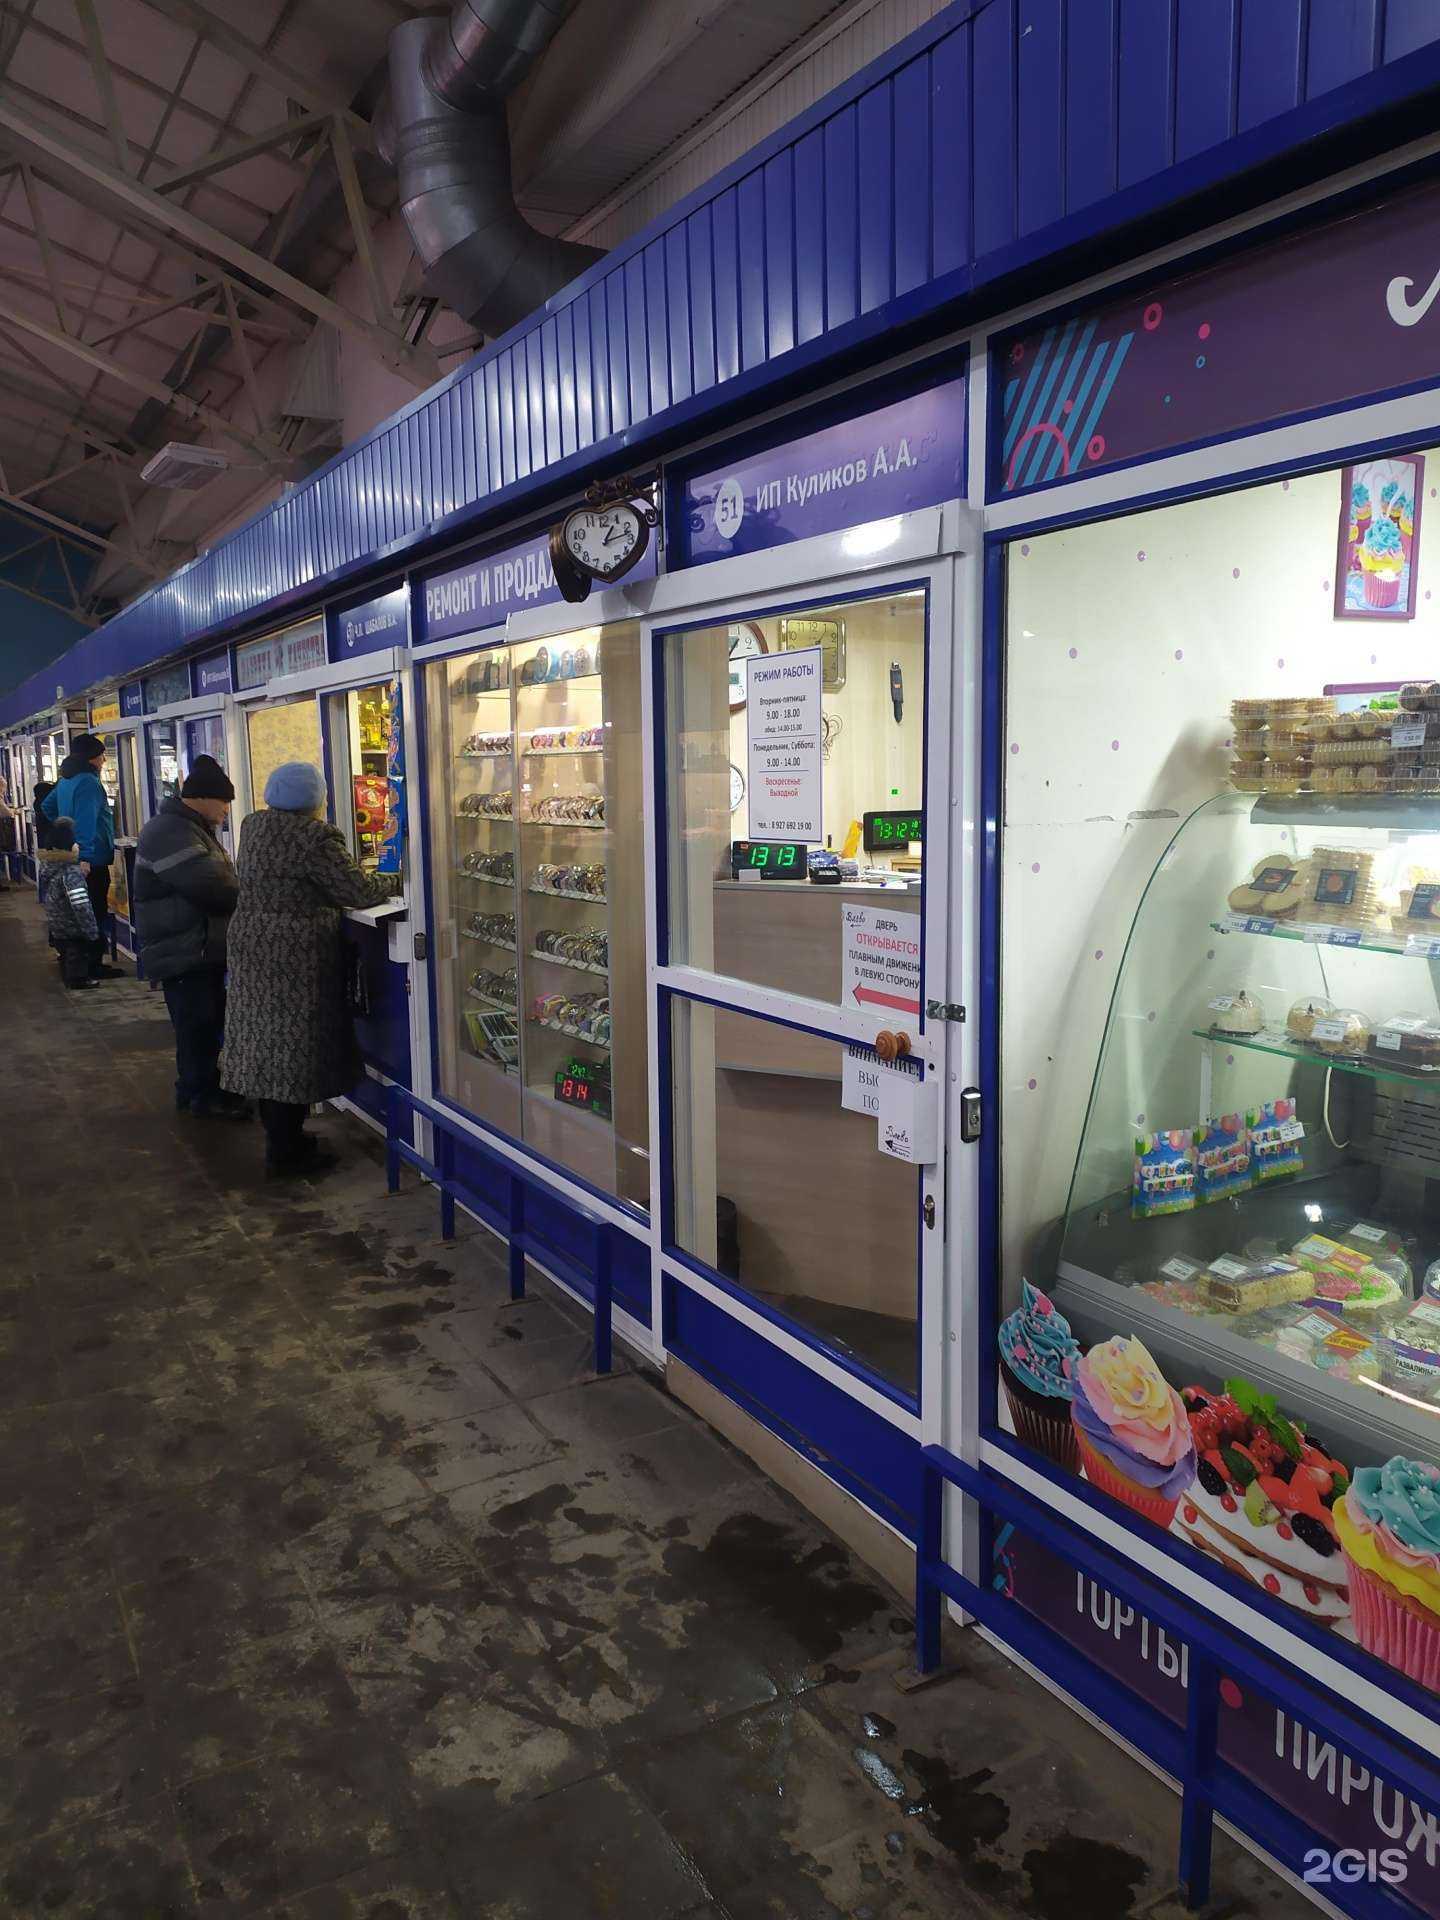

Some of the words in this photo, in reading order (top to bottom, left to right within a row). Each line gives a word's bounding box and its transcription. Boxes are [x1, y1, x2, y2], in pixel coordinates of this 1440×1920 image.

[721, 496, 738, 523] 51
[756, 480, 781, 512] ИП
[787, 459, 867, 506] Куликов
[873, 438, 918, 477] А.А.
[586, 515, 595, 527] 11
[599, 515, 610, 528] 12
[614, 513, 620, 524] 1
[624, 522, 631, 533] 2
[574, 528, 586, 540] 10
[627, 533, 634, 545] 3
[573, 542, 581, 553] 9
[582, 551, 590, 562] 8
[592, 558, 599, 567] 7
[603, 562, 611, 572] 6
[426, 574, 477, 622] РЕМОНТ
[480, 571, 491, 607] И
[754, 668, 781, 682] РЕЖИМ
[783, 664, 814, 678] РАБОТЫ
[766, 710, 779, 720] 9.00
[784, 708, 800, 719] 18.00
[766, 758, 779, 768] 9.00
[784, 757, 800, 767] 14.00
[776, 821, 785, 830] 927
[876, 920, 898, 932] ДВЕРЬ
[856, 933, 918, 955] ОТКРЫВАЕТСЯ
[848, 950, 884, 966] ПЛАВНЫМ
[854, 966, 859, 976] В
[860, 968, 884, 981] ЛЕВУЮ
[886, 974, 920, 990] СТОРОНУ
